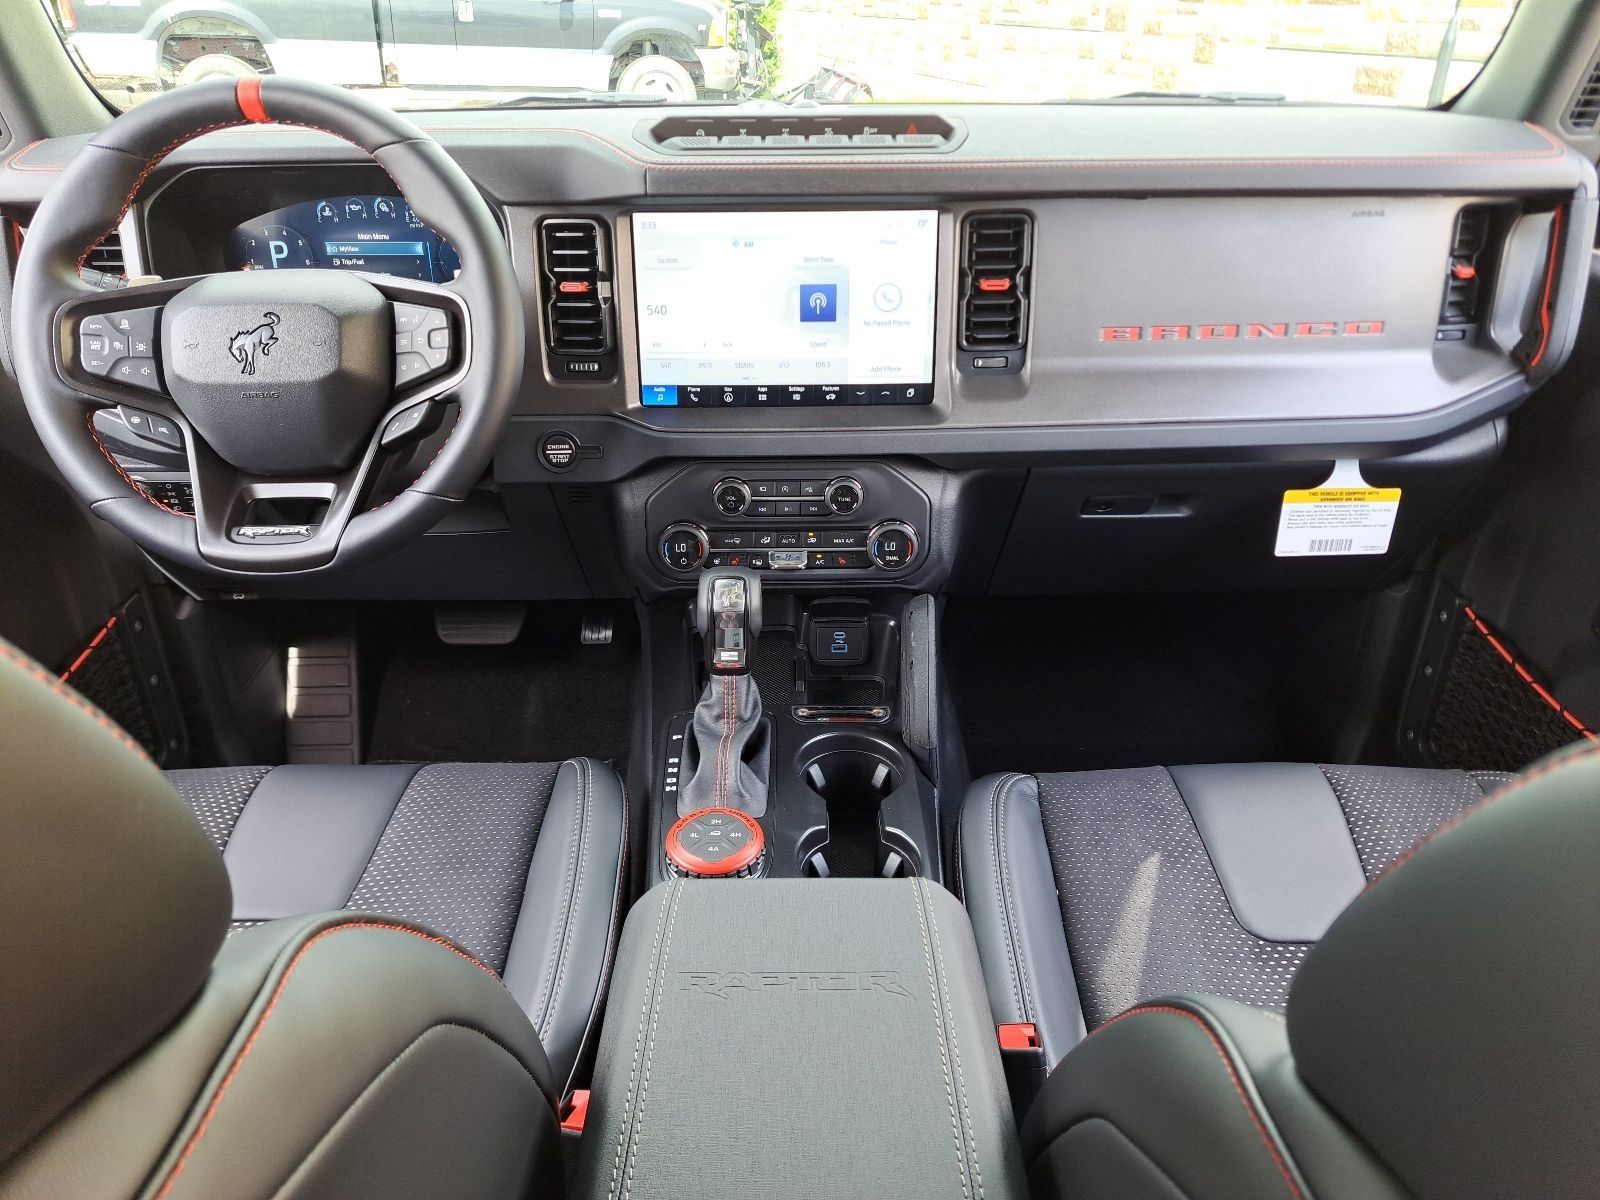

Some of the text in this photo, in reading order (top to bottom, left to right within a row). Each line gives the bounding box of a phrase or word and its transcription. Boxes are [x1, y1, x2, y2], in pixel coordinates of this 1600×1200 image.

[1350, 209, 1386, 218] AIRBAG
[268, 240, 288, 268] P
[657, 255, 679, 265] Sources
[646, 304, 668, 316] 540
[1099, 320, 1385, 343] BRONCO
[240, 391, 280, 399] AIRBAG
[237, 526, 313, 539] RAPTOR
[675, 543, 687, 553] LO
[884, 541, 896, 551] LO
[677, 970, 918, 1001] RAPTOR
